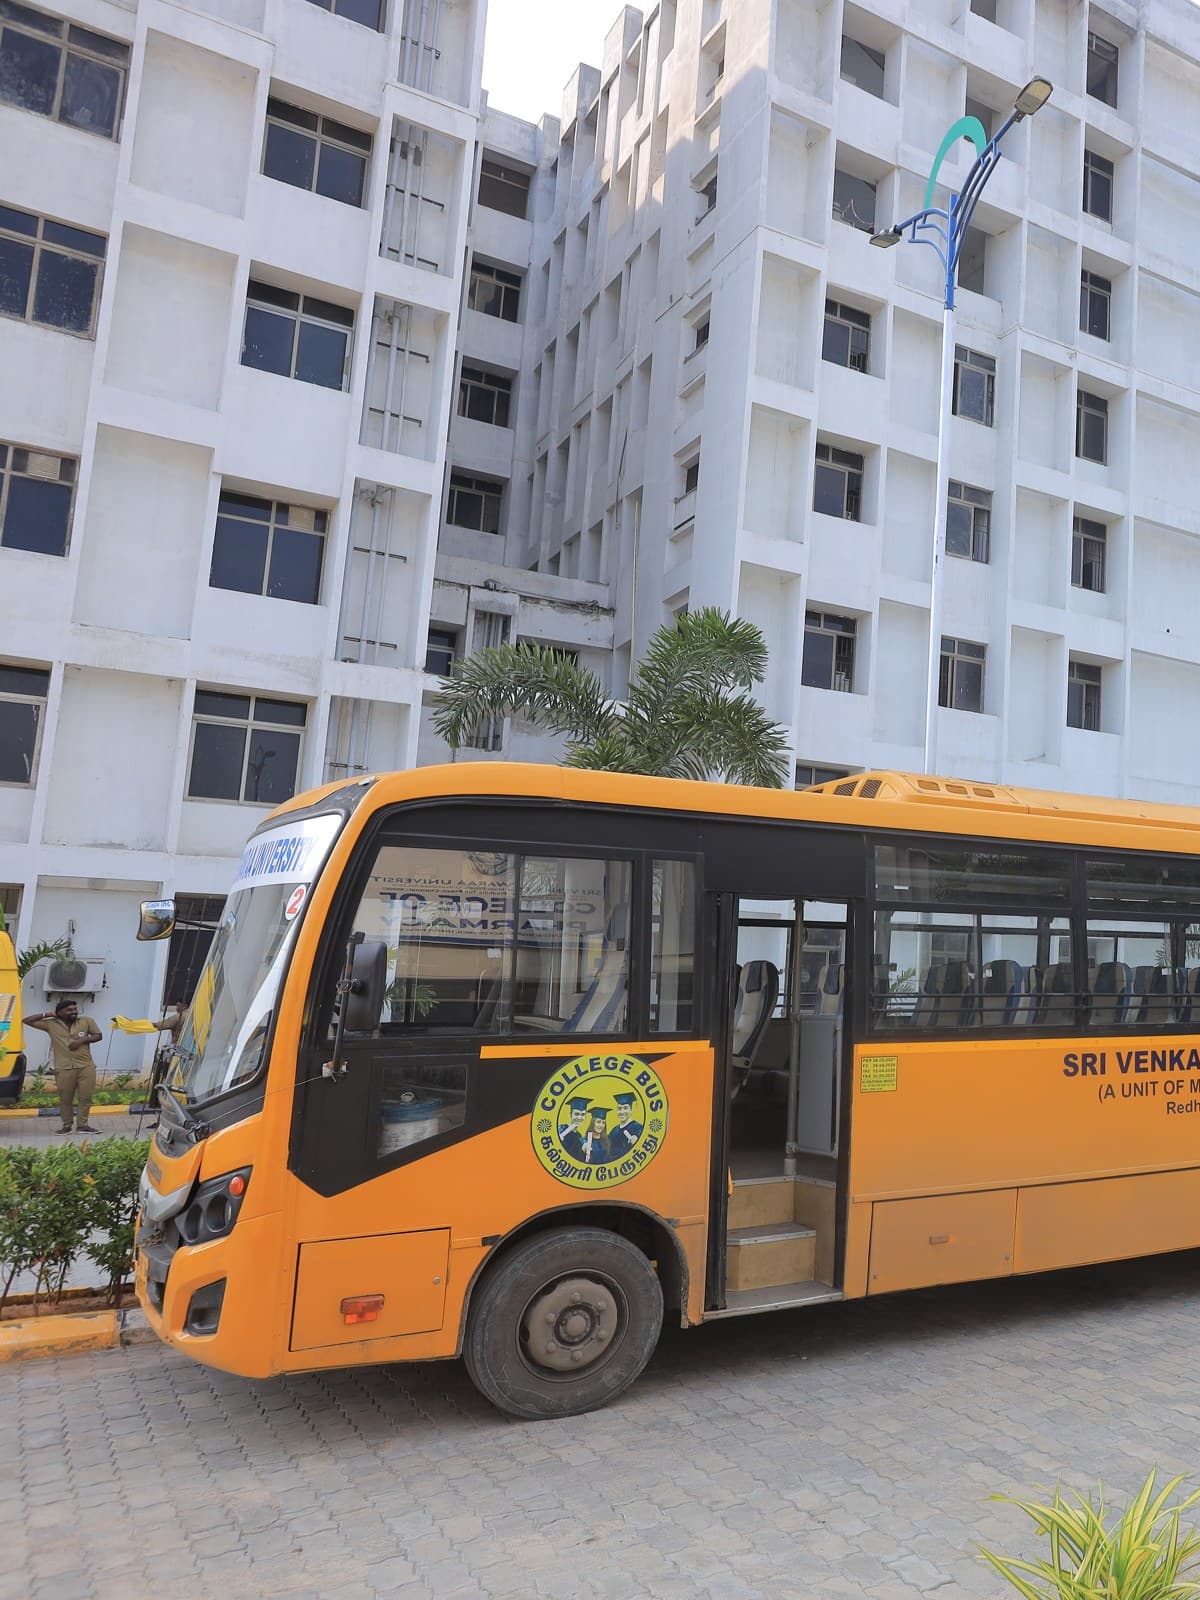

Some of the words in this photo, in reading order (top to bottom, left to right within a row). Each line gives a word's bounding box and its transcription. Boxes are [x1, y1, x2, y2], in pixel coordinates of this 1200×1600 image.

[287, 888, 304, 914] 2
[1063, 1053, 1106, 1077] SRI
[540, 1057, 634, 1111] COLLEGE
[635, 1070, 663, 1112] BUS
[1098, 1084, 1115, 1103] (A
[1121, 1081, 1158, 1098] UNIT
[1163, 1079, 1184, 1095] OF
[540, 1136, 593, 1182] கல்லூரி
[595, 1134, 659, 1182] பேருந்து
